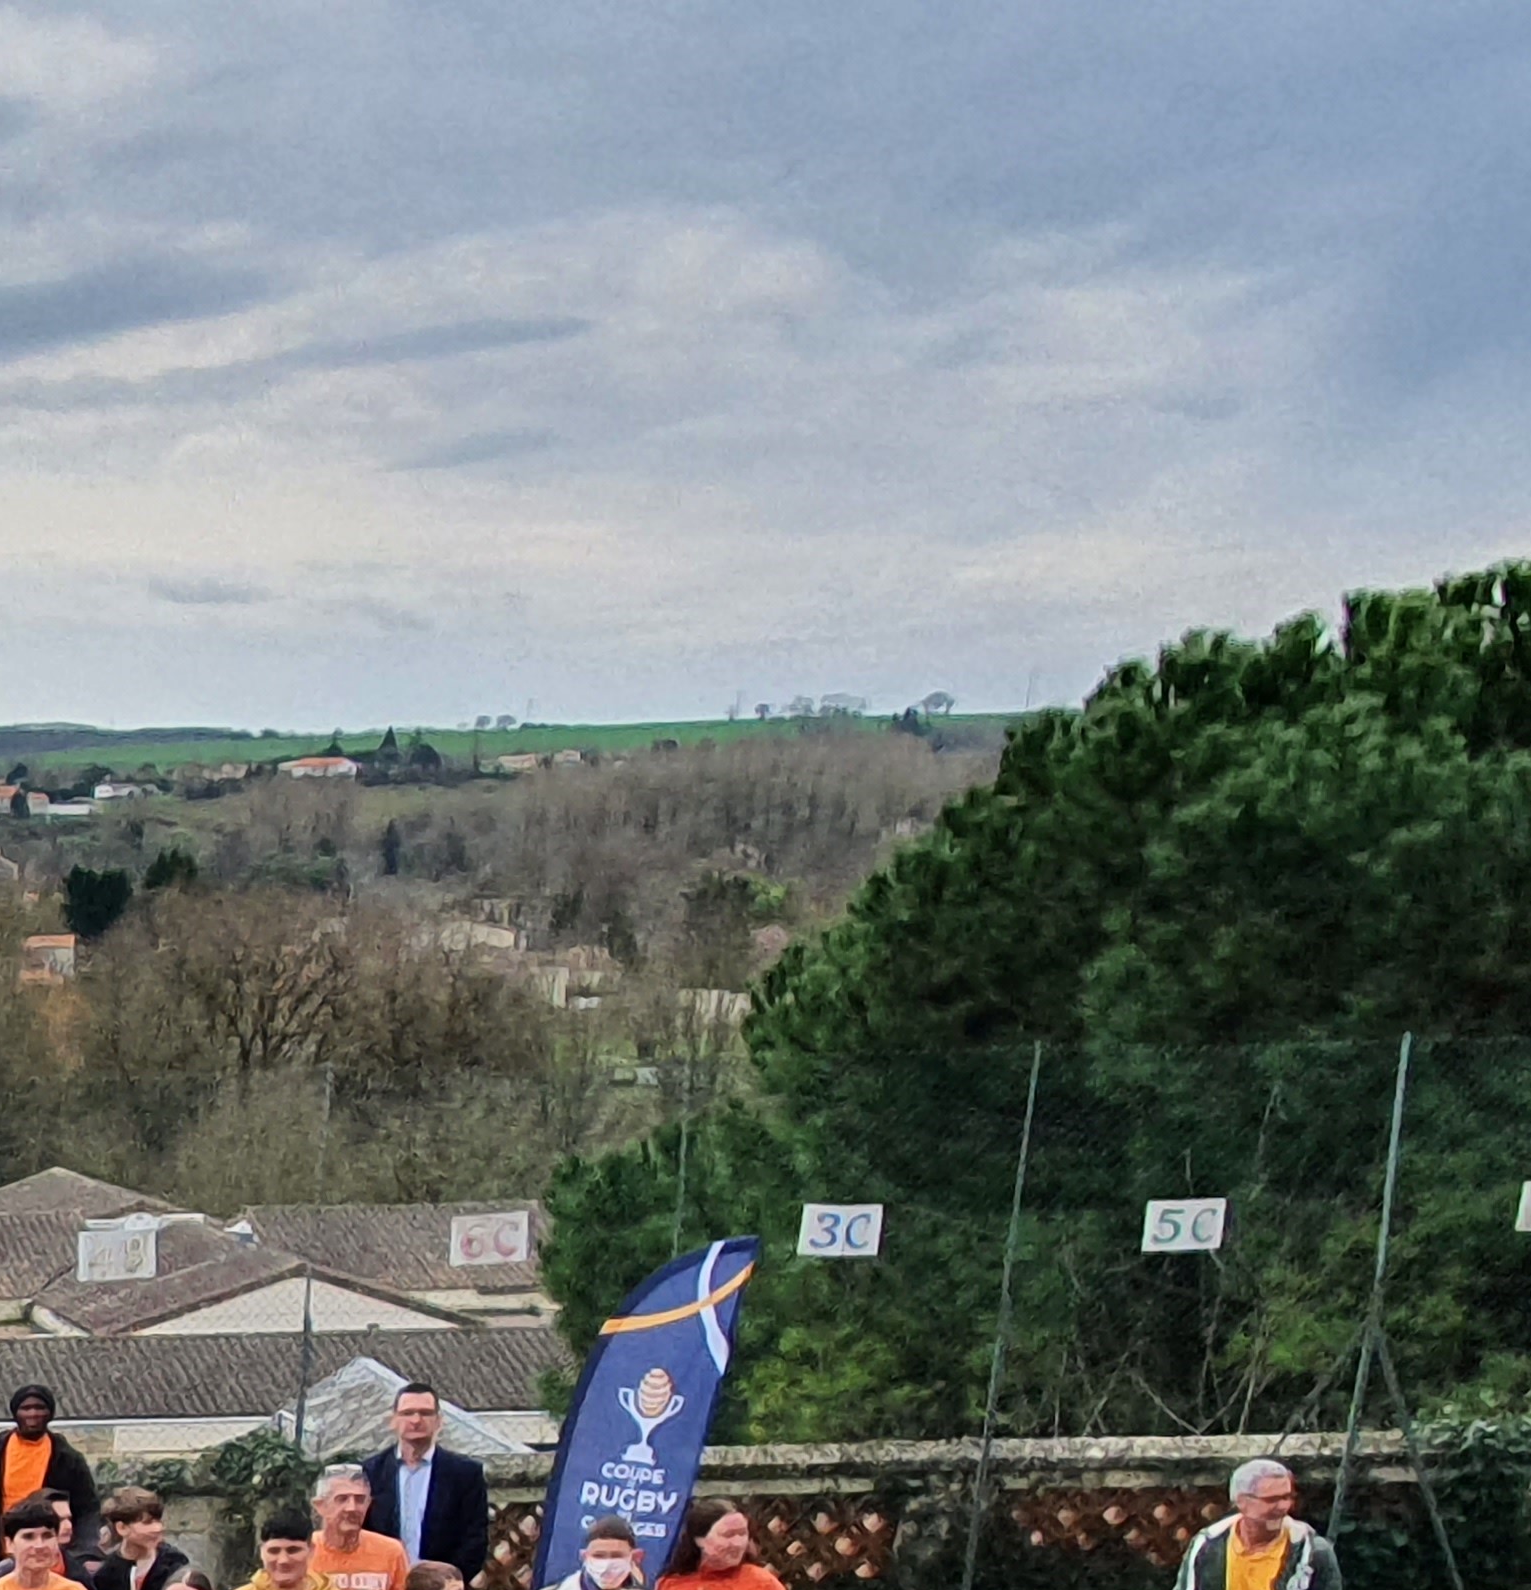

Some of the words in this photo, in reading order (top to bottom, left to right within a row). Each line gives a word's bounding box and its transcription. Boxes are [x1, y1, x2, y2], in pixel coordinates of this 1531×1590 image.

[459, 1221, 520, 1260] 6C
[808, 1213, 872, 1249] 3C
[1153, 1208, 1218, 1244] 5C
[601, 1461, 665, 1485] COUPE
[580, 1480, 678, 1515] RUGBY
